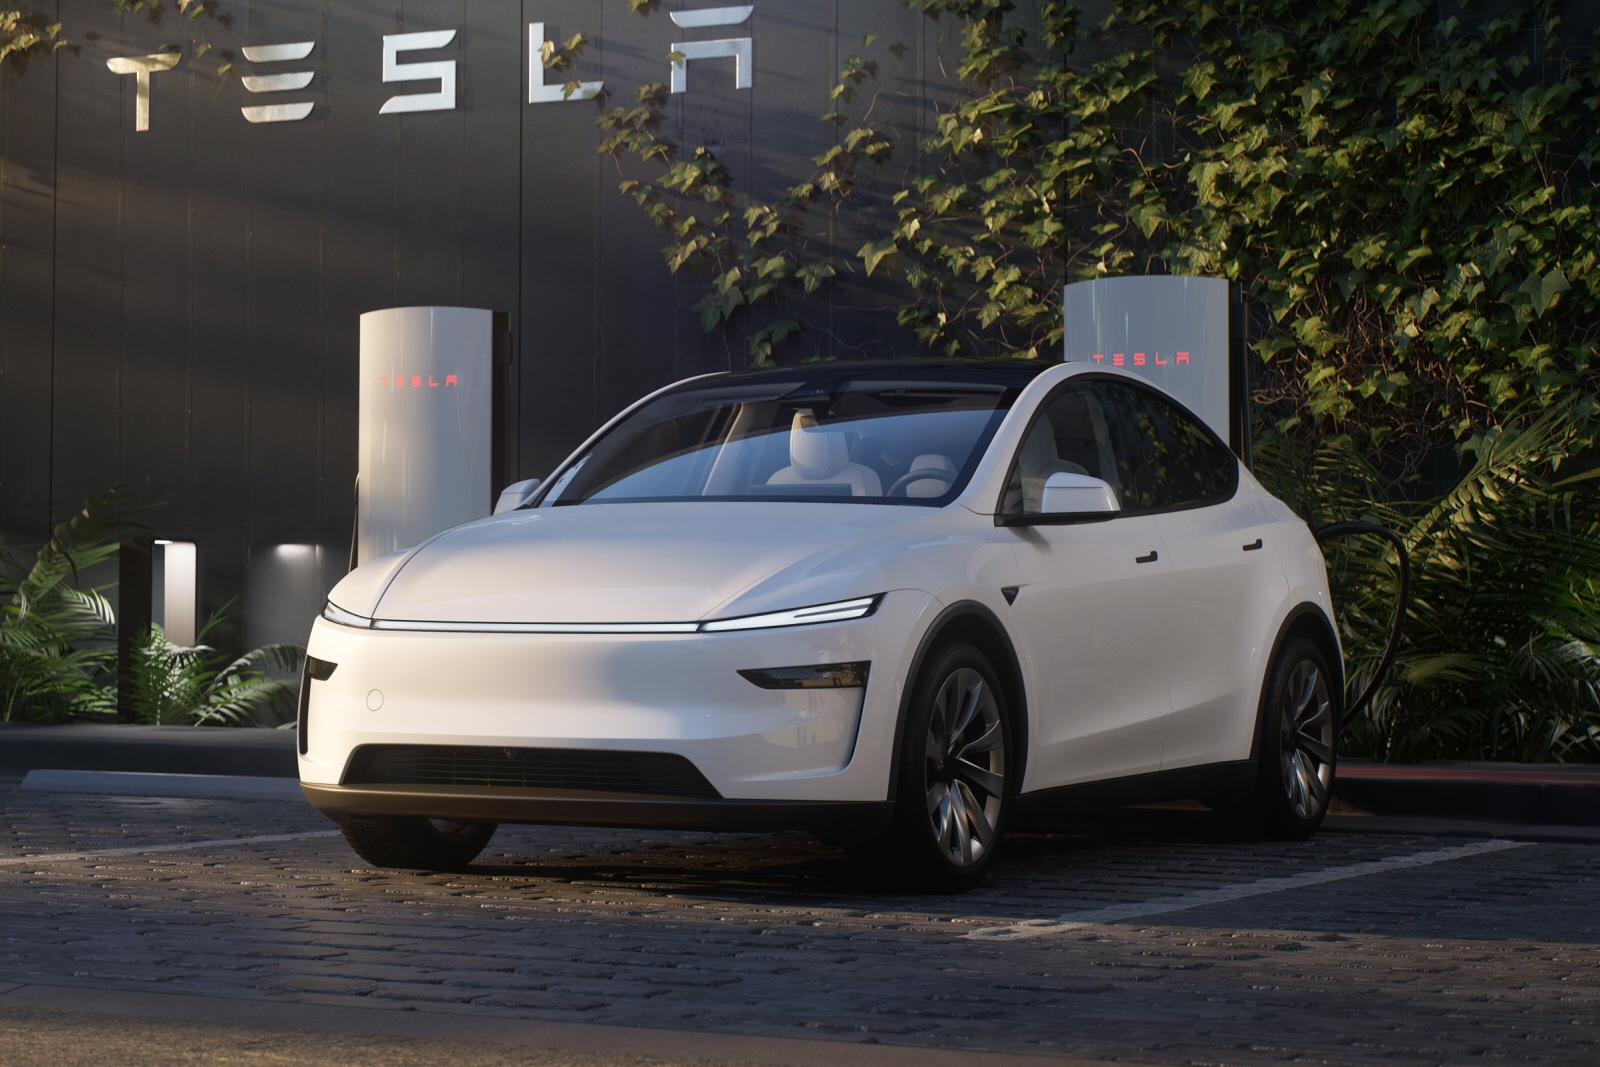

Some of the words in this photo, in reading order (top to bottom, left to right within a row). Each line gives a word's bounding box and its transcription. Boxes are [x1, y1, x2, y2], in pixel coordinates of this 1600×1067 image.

[107, 5, 754, 132] TESLA
[1092, 351, 1190, 367] TESLA
[380, 374, 458, 389] TESLA
